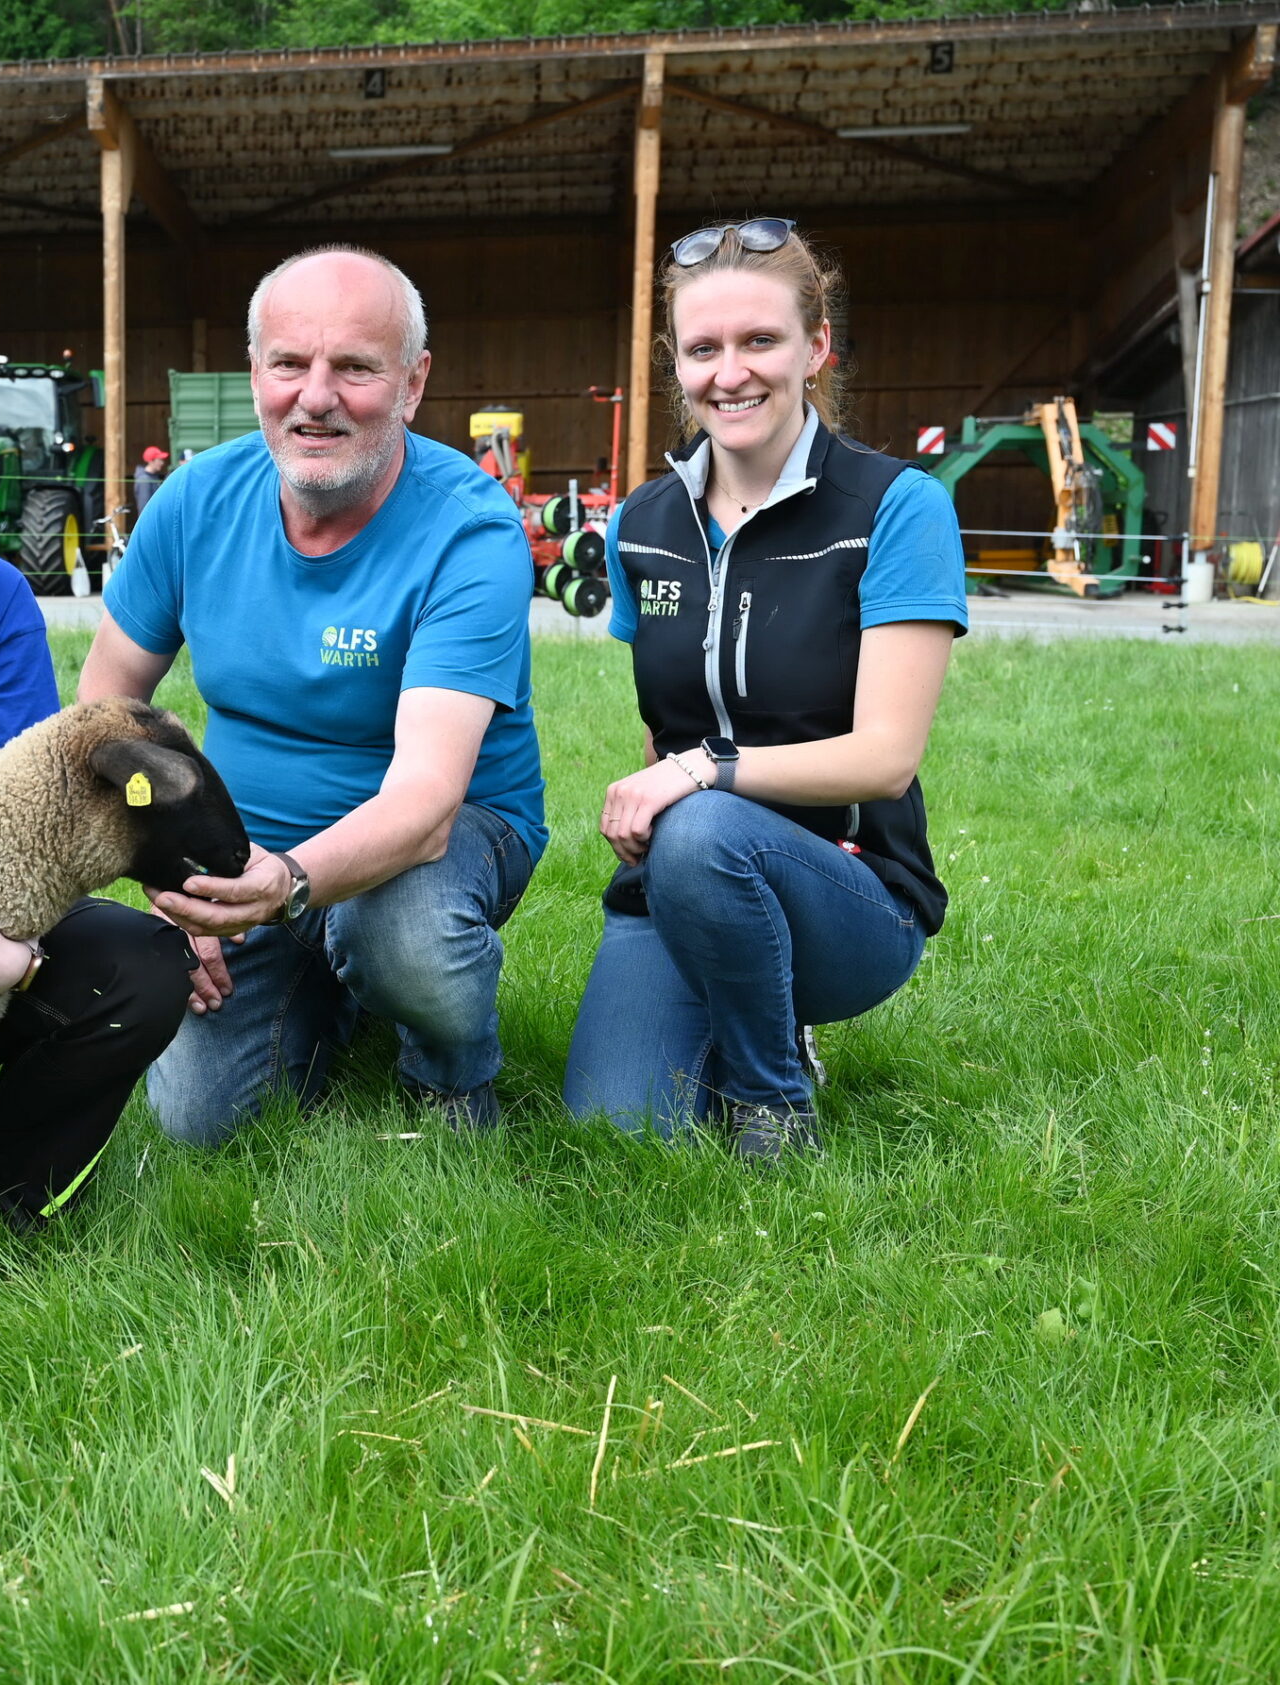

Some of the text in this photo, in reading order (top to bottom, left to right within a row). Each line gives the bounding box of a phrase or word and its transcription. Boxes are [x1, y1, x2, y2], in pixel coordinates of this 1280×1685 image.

[934, 46, 951, 71] 5
[366, 72, 382, 95] 4
[647, 579, 682, 601] LFS
[337, 627, 378, 652] LFS
[320, 648, 380, 667] WARTH
